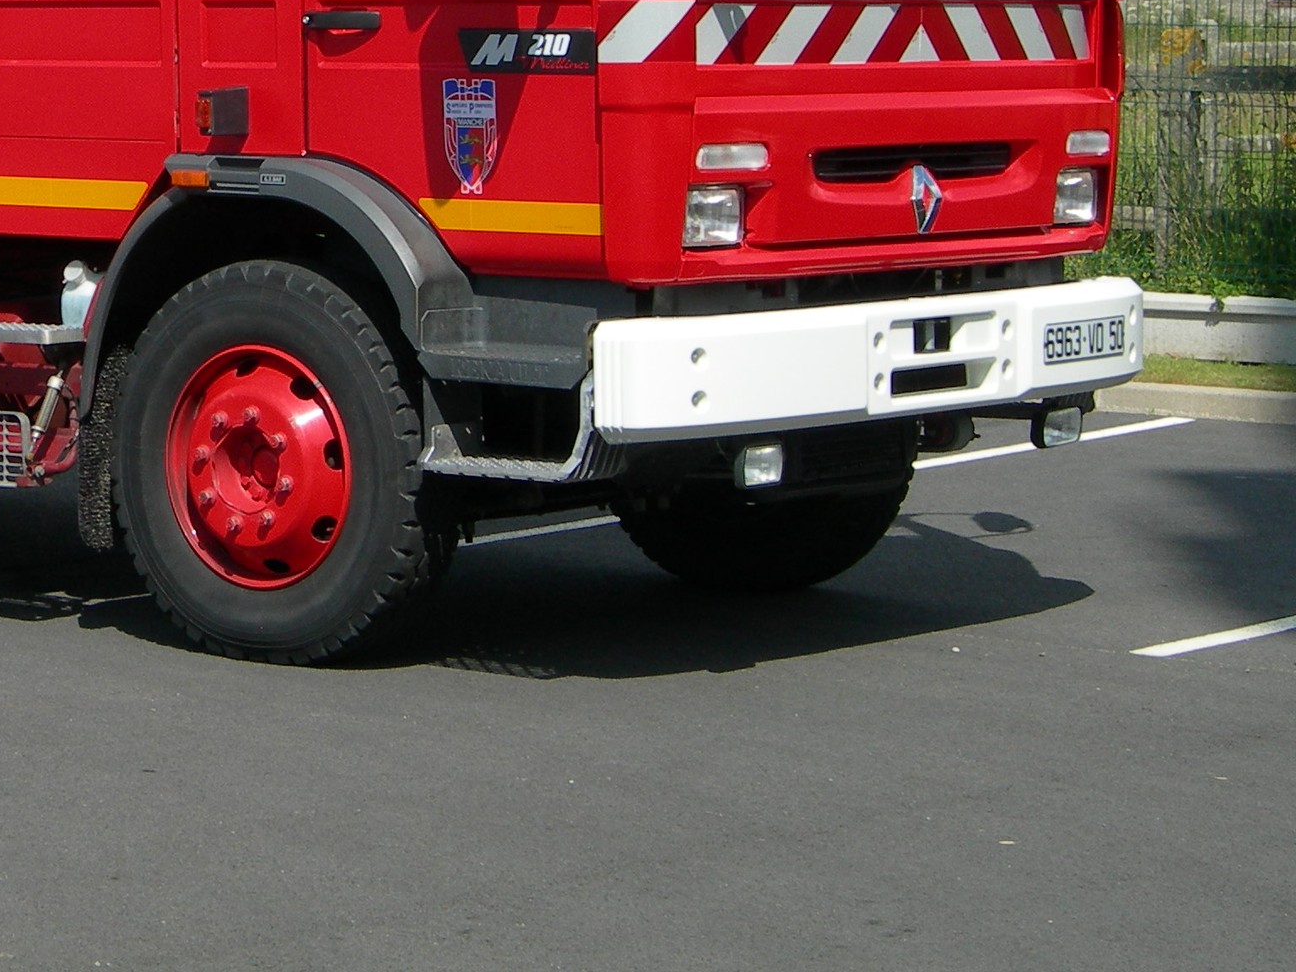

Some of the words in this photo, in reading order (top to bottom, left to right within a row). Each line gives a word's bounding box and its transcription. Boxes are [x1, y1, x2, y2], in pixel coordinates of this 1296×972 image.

[470, 34, 519, 65] M
[528, 34, 571, 56] 210
[457, 117, 483, 126] MANCHE
[1046, 326, 1082, 359] 6963
[1088, 323, 1104, 354] VD
[1109, 320, 1123, 350] 50
